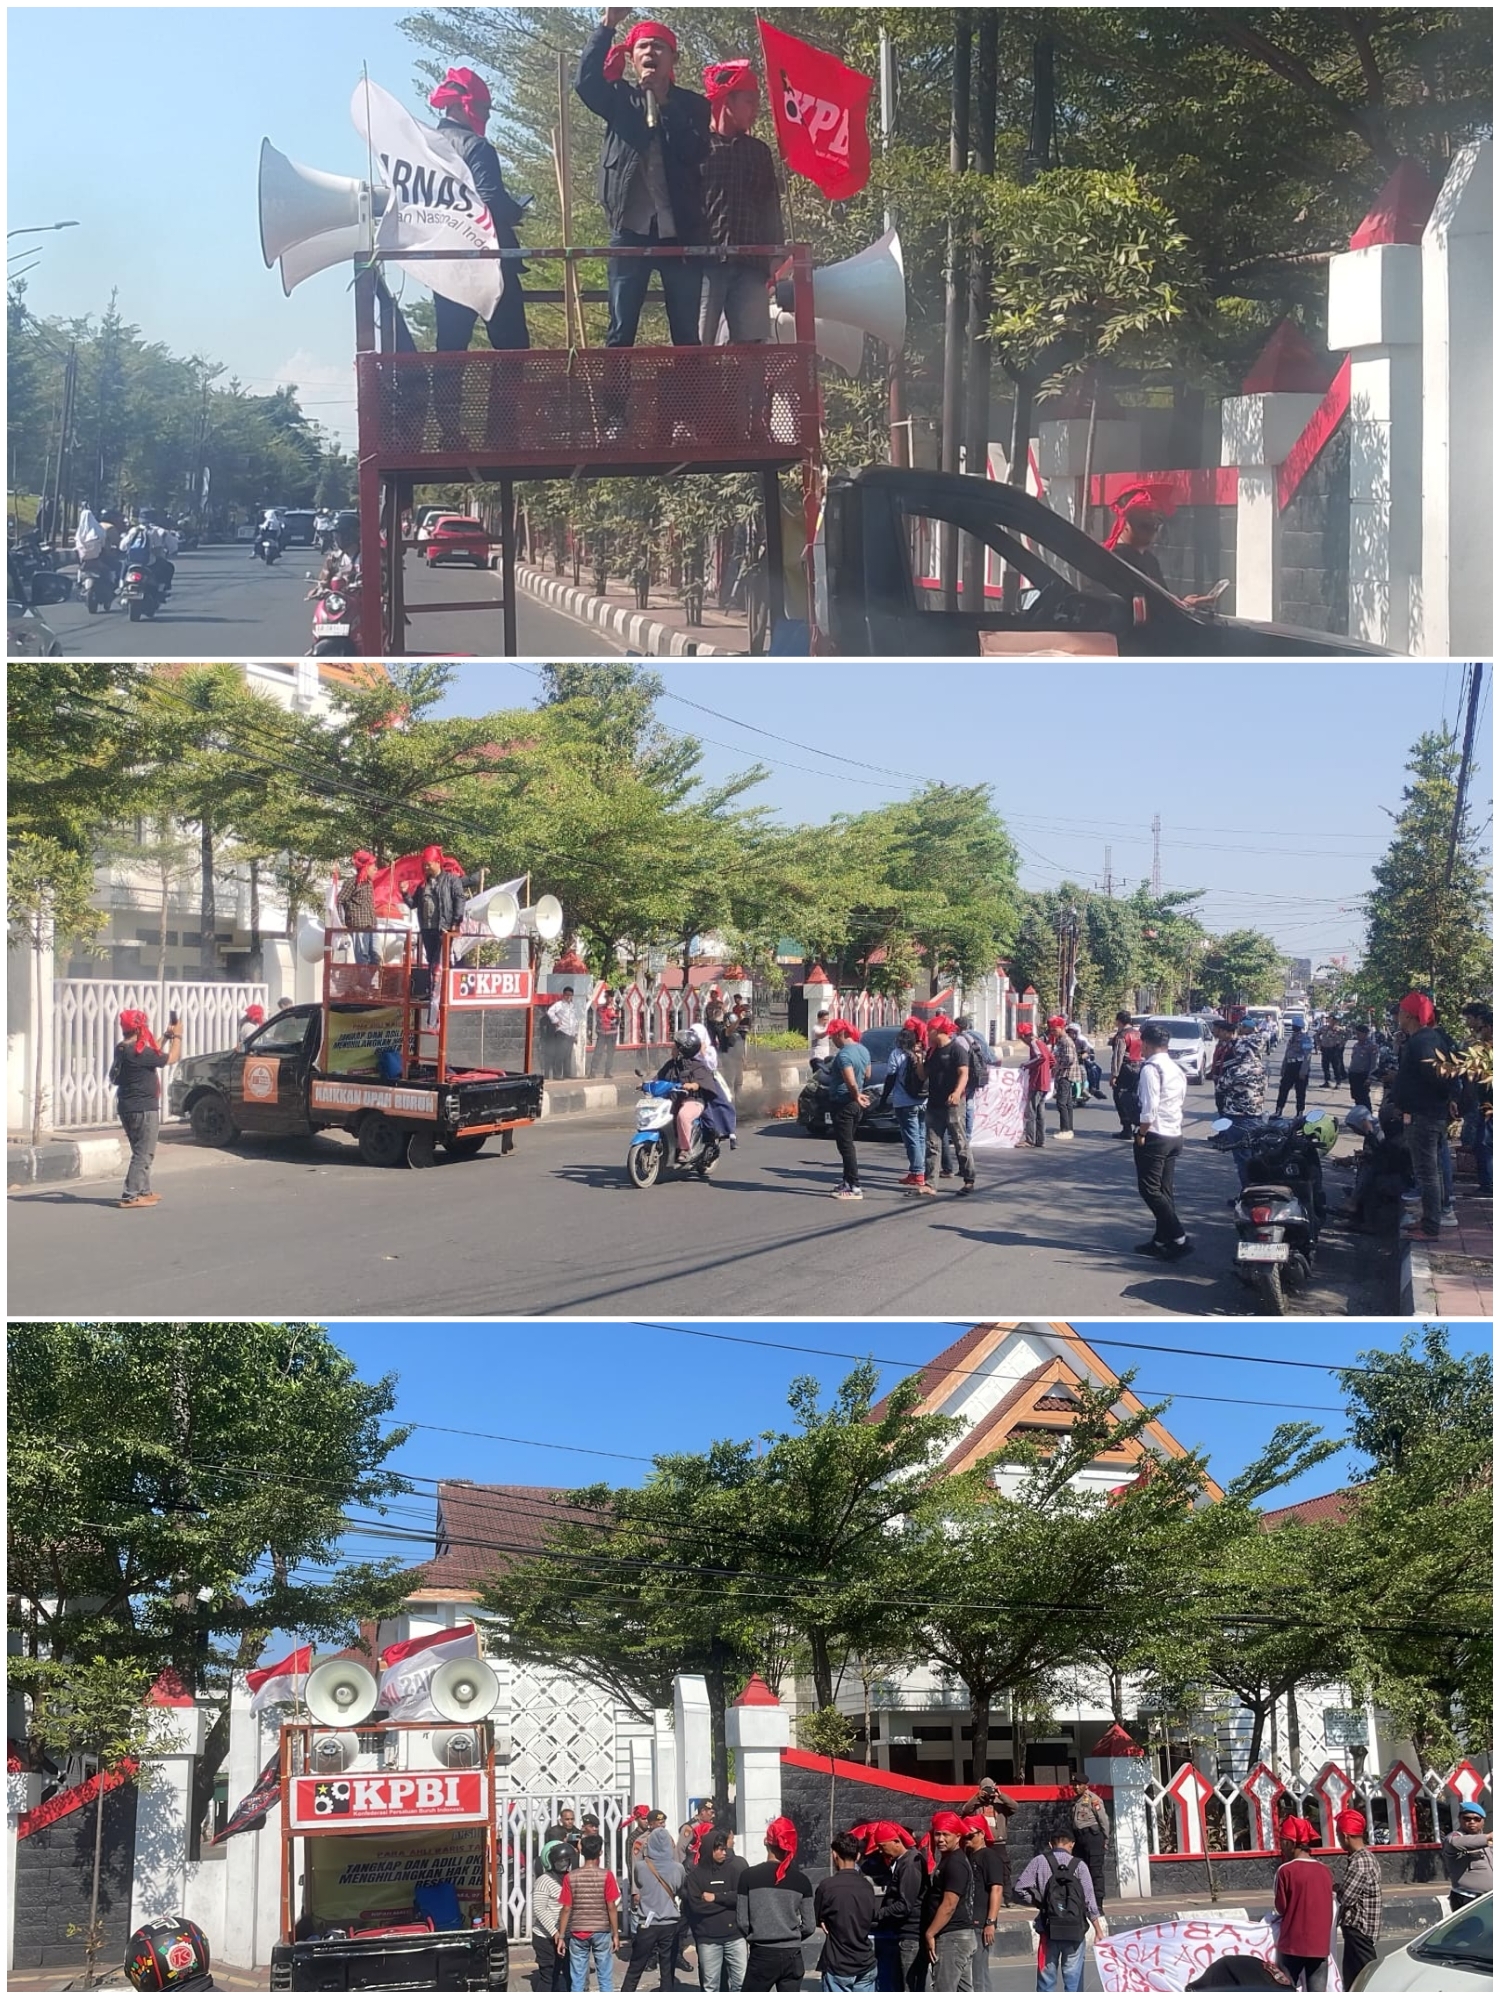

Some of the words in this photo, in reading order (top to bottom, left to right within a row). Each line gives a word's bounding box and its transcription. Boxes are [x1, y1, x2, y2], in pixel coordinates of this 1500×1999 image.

[476, 973, 521, 995] KPBI
[315, 1087, 361, 1105] NAIKKAN
[353, 1777, 460, 1811] KPBI
[339, 1868, 446, 1884] MENGHILANGKAN
[445, 1865, 469, 1877] HAK
[346, 1860, 402, 1874] TANGKAP
[404, 1858, 429, 1870] DAN
[432, 1856, 463, 1868] ADILI
